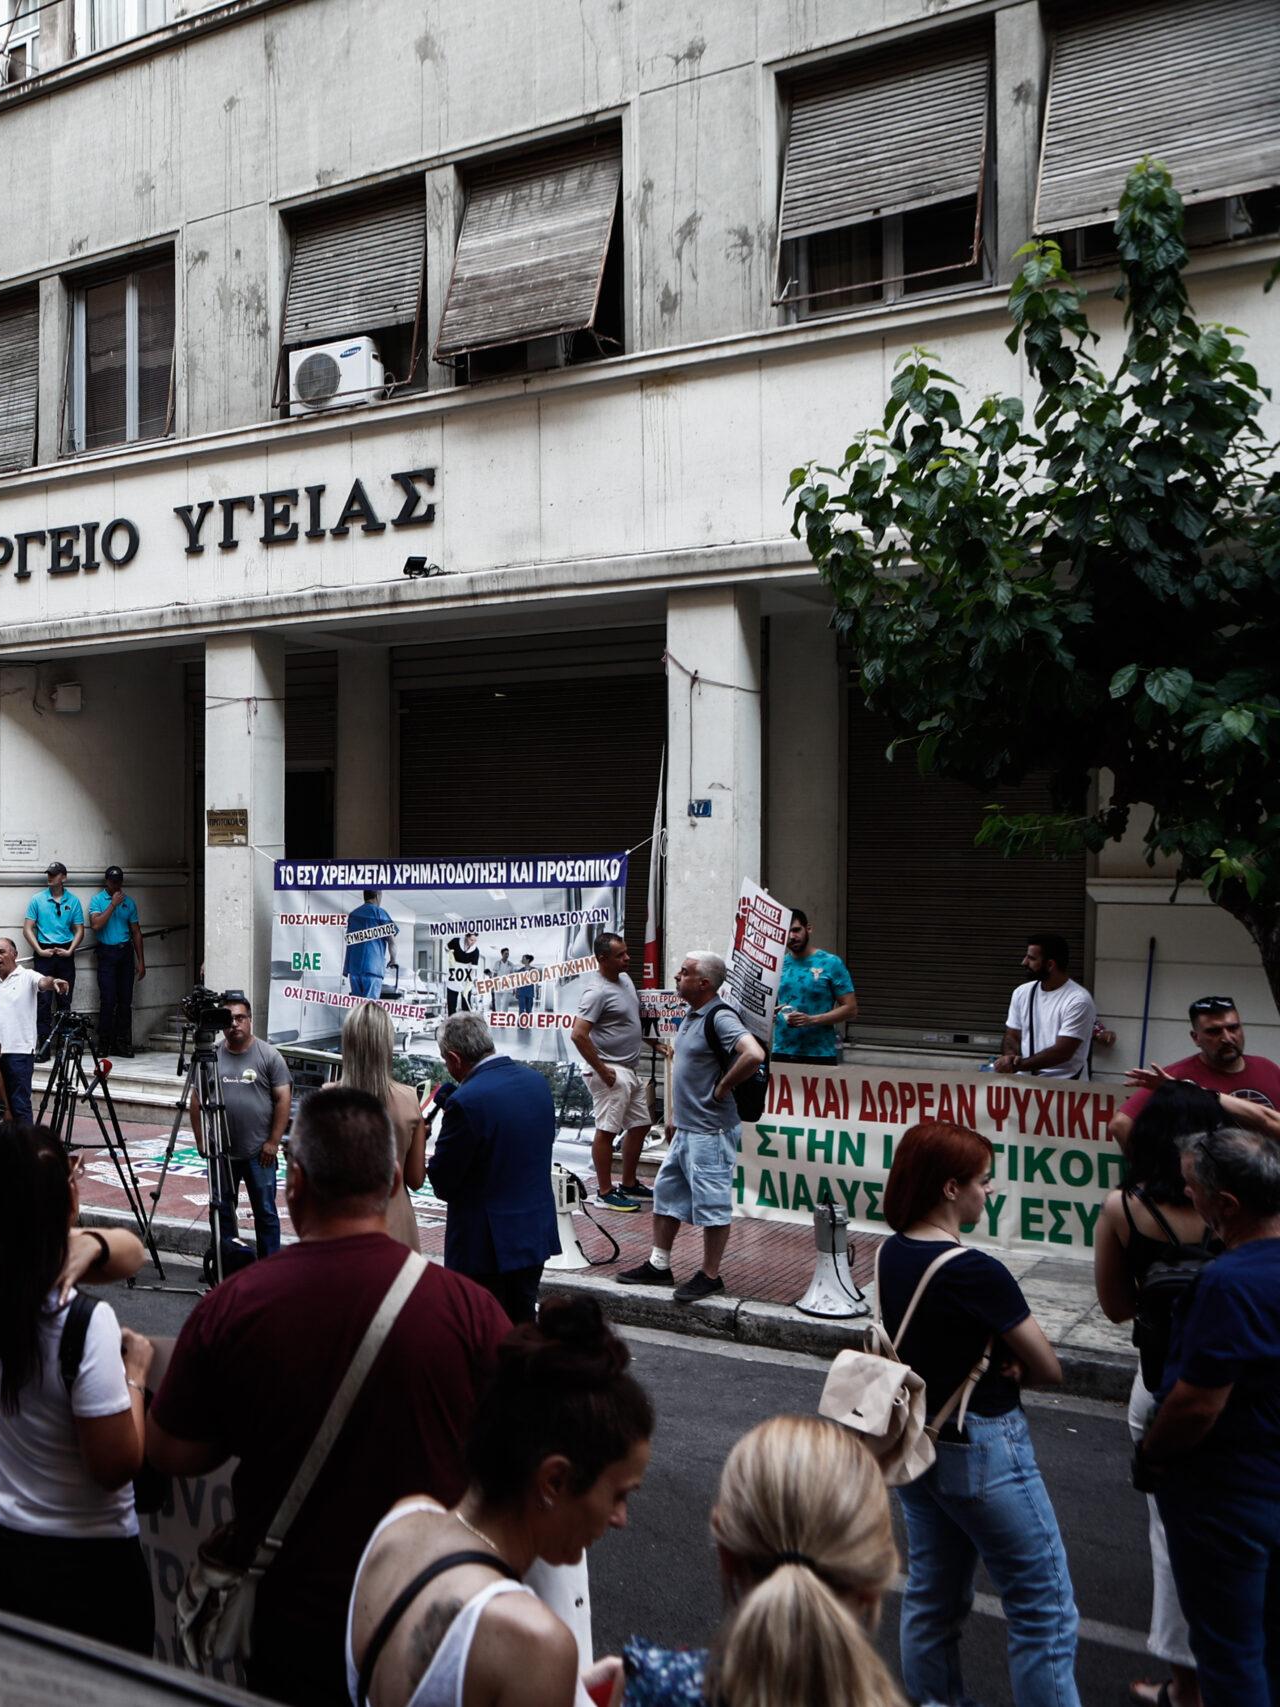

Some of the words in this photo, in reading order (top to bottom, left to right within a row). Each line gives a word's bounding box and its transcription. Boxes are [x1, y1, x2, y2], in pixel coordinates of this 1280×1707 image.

[172, 467, 437, 555] ΥΓΕΙΑΣ
[280, 864, 294, 886] ΤΟ
[297, 864, 319, 886] ΕΣΥ
[320, 863, 391, 886] ΧΡΕΙΑΖΕΤΑΙ
[393, 861, 507, 885] ΧΡΗΜΑΤΟΔΟΤΗΣΗ
[510, 861, 534, 884] ΚΑΙ
[537, 858, 621, 883] ΠΡΟΣΩΠΙΚΟ
[430, 916, 517, 936] ΜΟΝΙΜΟΠΟΙΗΣΗ
[520, 908, 610, 930] ΣΥΜΒΑΣΙΟΥΧΩΝ
[756, 898, 780, 921] ΜΑΖΙΚΕΣ
[292, 952, 321, 971] ΒΑΕ
[448, 968, 473, 982] ΣΟΧ
[477, 970, 540, 995] ΕΡΓΑΤΙΚΟ
[543, 955, 598, 981] ΑΤΥΧΗΜ
[284, 986, 302, 999] ΟΧΙ
[305, 989, 326, 1003] ΣΤΙΣ
[519, 1013, 533, 1027] ΟΙ
[801, 1076, 849, 1120] ΚΑΙ
[859, 1080, 977, 1131] ΔΩΡΕΑΝ
[987, 1085, 1119, 1143] ΨΥΧΙΚΗ
[755, 1124, 866, 1168] ΣΤΗΝ
[756, 1167, 886, 1223] ΔΙΑΛΥΣ
[1021, 1197, 1100, 1248] ΕΣΥ
